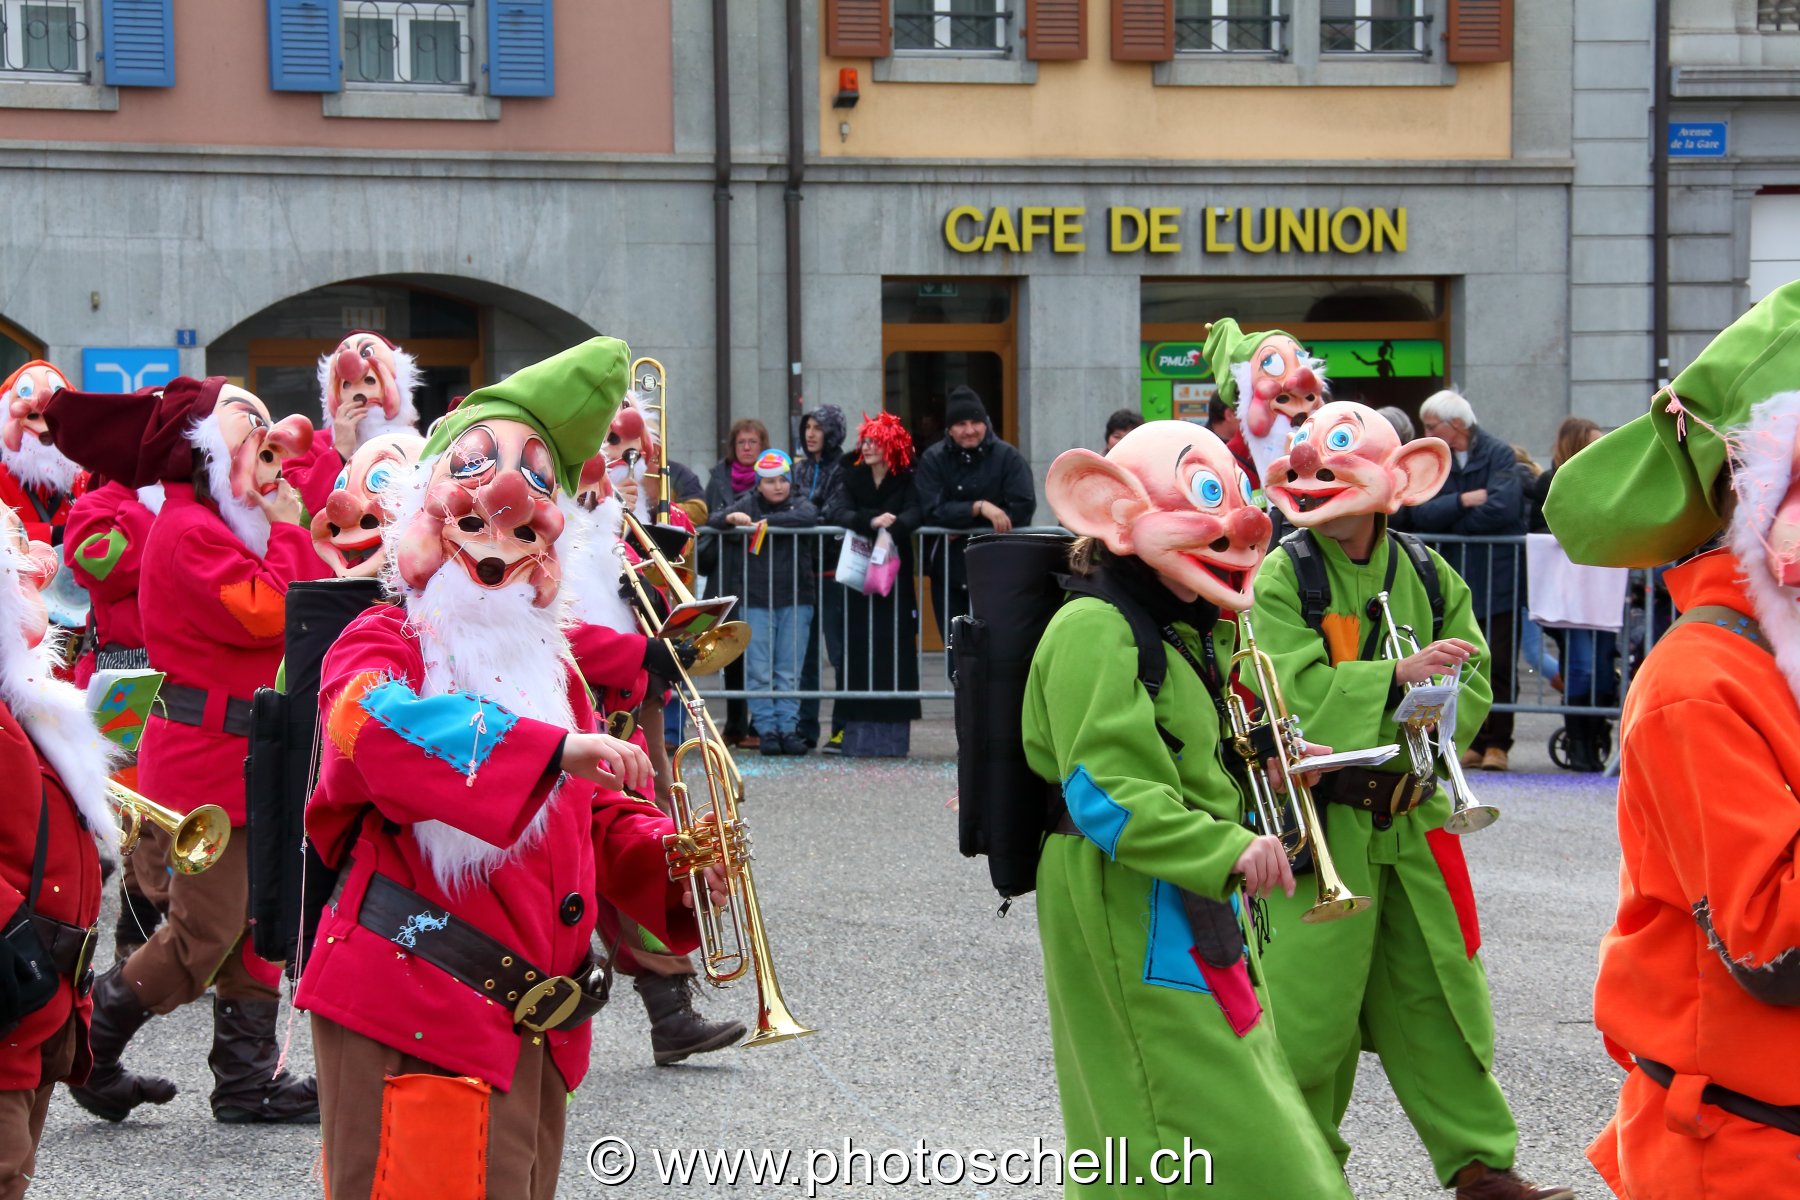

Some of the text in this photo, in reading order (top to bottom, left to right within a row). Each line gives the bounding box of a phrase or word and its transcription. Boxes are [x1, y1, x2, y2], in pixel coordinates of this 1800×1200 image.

[1679, 128, 1713, 137] Avenue
[1670, 139, 1719, 149] de la Gare
[945, 207, 1406, 253] CAFE DE L'UNION
[1159, 355, 1186, 367] PMU
